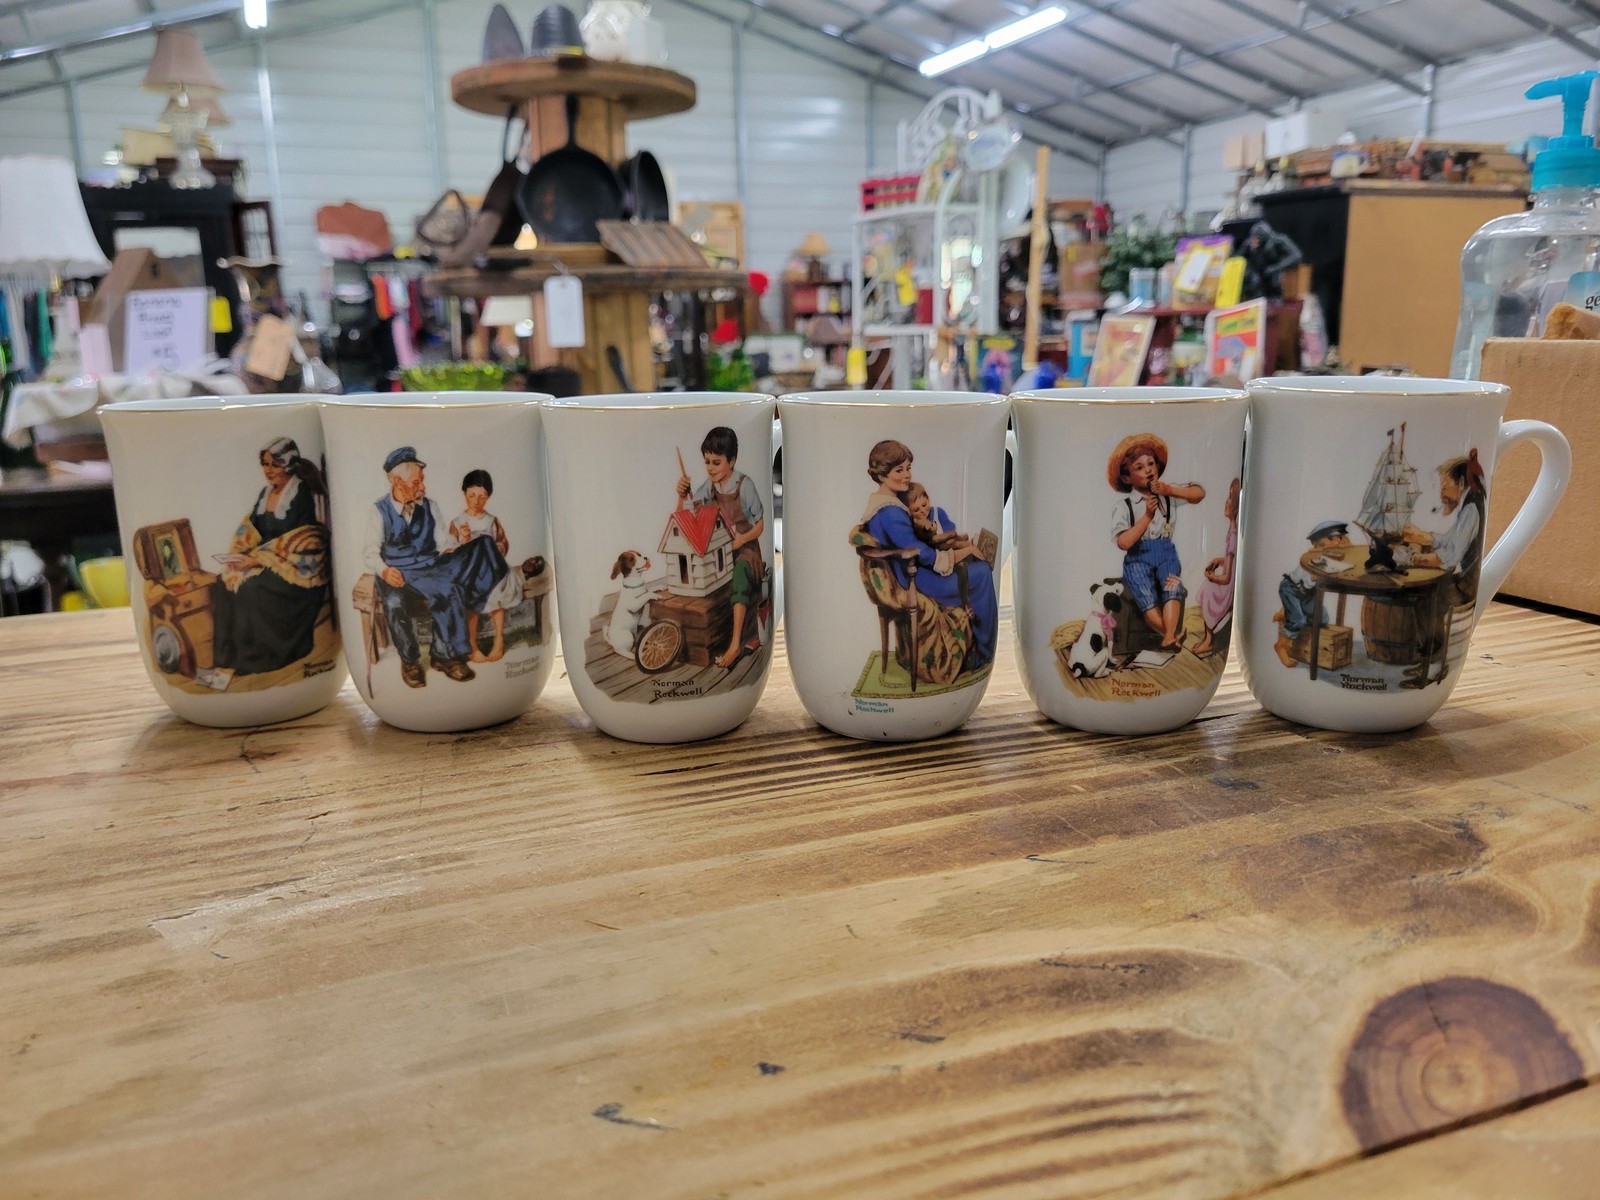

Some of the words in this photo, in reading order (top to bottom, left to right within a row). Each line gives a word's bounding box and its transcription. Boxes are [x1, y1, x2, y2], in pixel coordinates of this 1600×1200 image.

[651, 679, 694, 687] Norman
[1111, 678, 1155, 688] Norman
[1340, 673, 1384, 684] Norman
[1340, 681, 1388, 691] Rockwell
[653, 687, 702, 699] Rockwell
[1111, 687, 1161, 697] Rockwell
[855, 698, 888, 707] Norman
[855, 705, 895, 713] Rockwell
